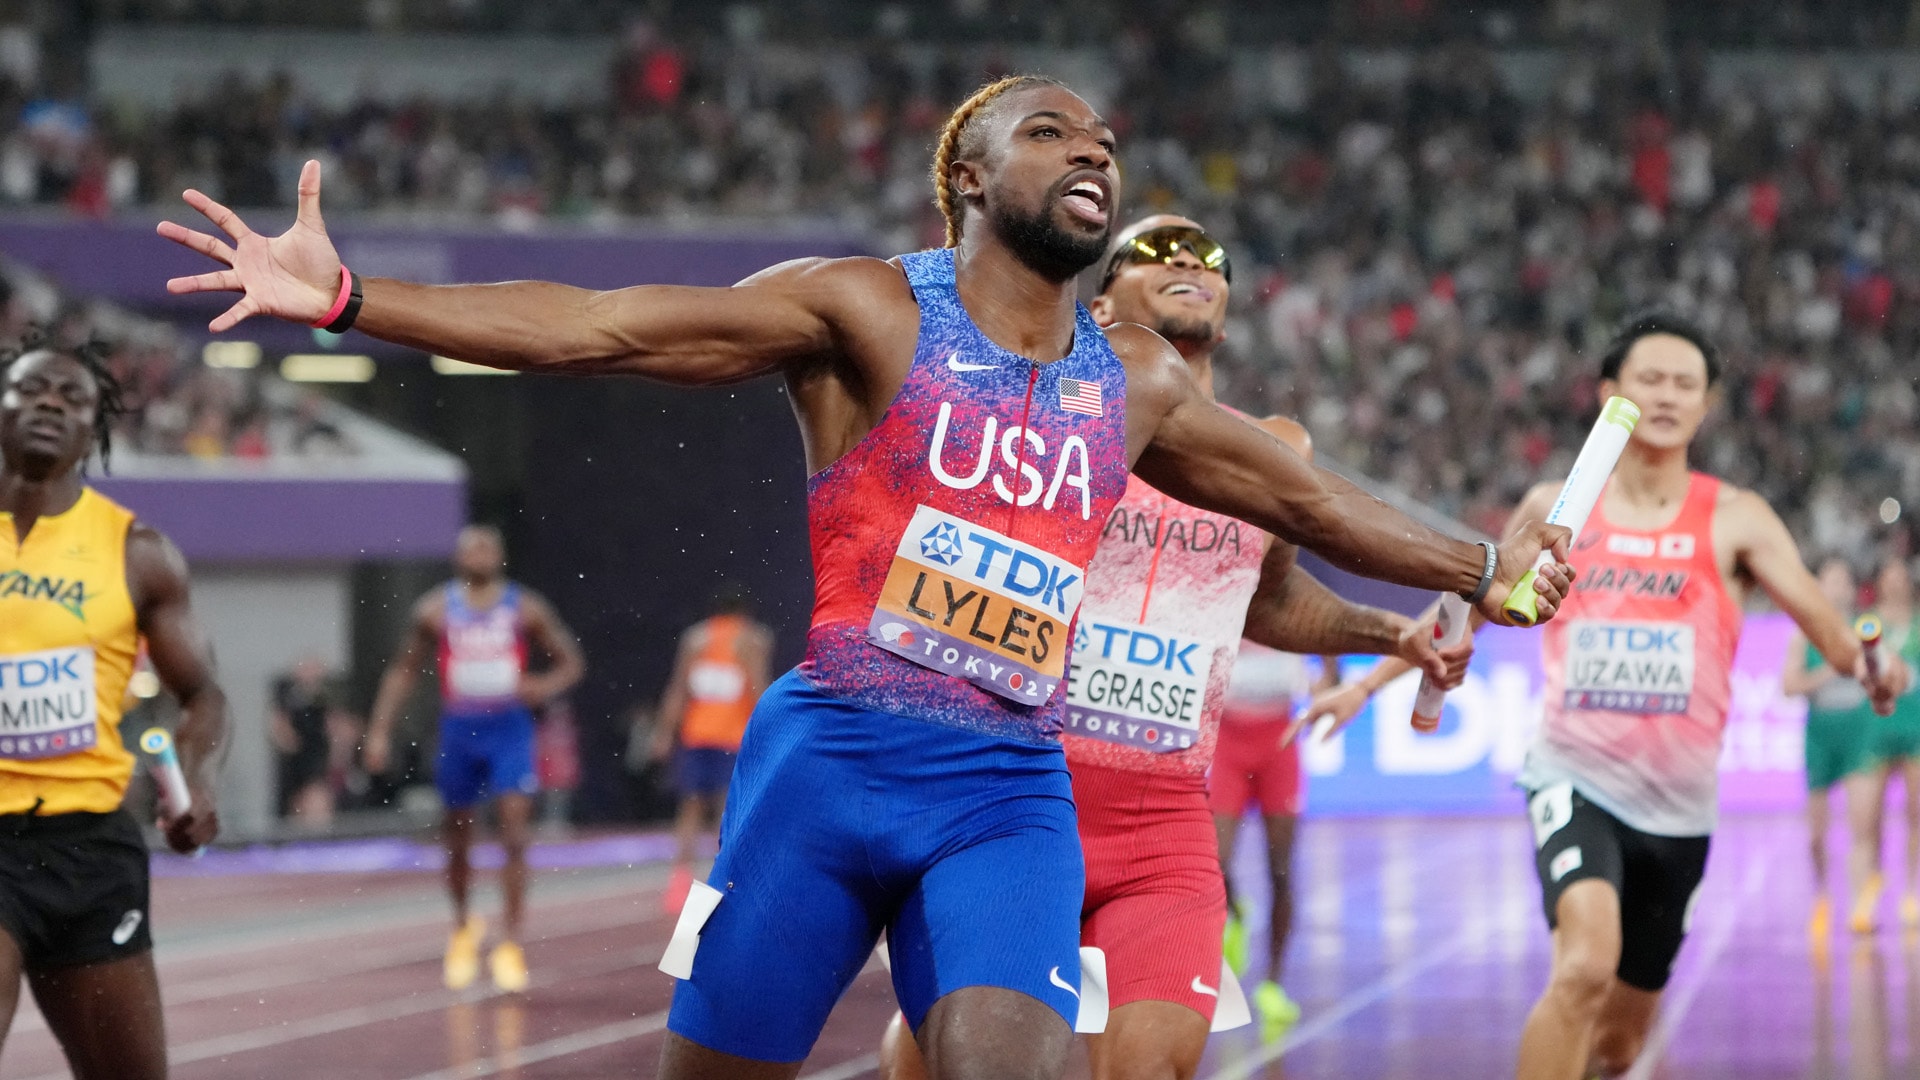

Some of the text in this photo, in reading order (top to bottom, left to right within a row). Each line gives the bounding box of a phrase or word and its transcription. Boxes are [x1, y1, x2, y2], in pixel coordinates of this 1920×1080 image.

[929, 401, 1091, 521] USA
[1103, 507, 1241, 557] ANADA
[0, 574, 84, 606] ANA
[967, 531, 1080, 615] TDK
[1576, 565, 1688, 599] JAPAN
[906, 571, 1054, 664] LYLES
[1599, 626, 1681, 653] TDK
[1092, 623, 1201, 677] TDK
[1573, 659, 1684, 687] UZAWA
[1, 690, 86, 729] MINU
[1066, 664, 1197, 722] E GRASSE
